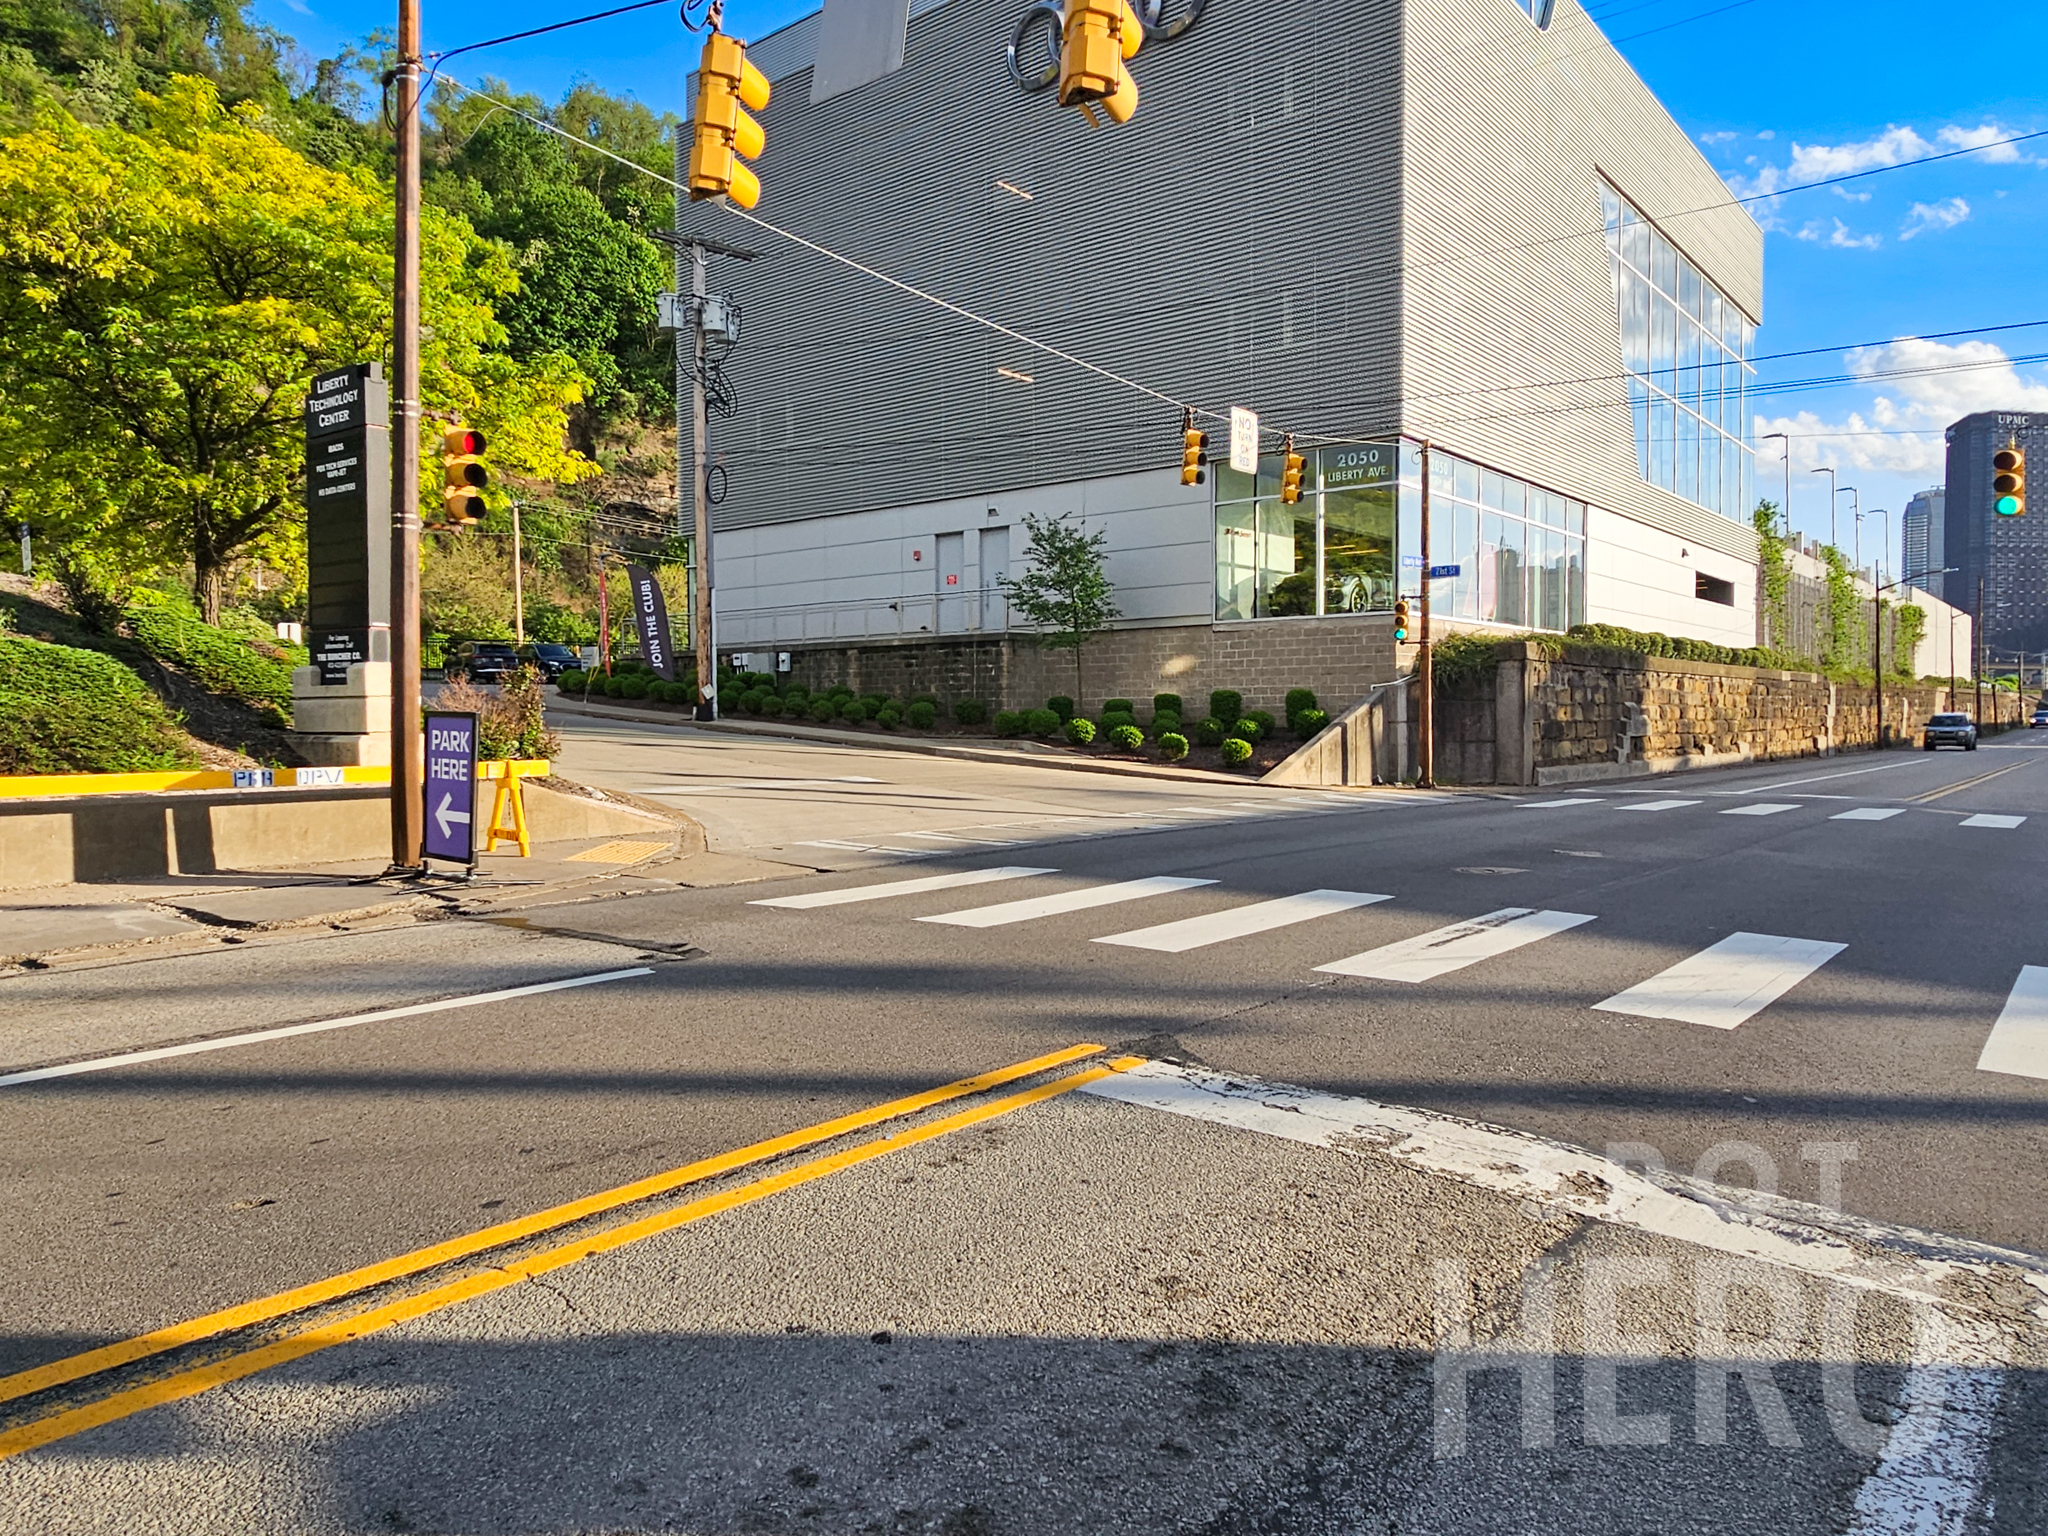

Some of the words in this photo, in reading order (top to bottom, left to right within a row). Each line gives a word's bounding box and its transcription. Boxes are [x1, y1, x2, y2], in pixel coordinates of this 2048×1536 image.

[317, 374, 349, 394] LIBERTY
[309, 389, 359, 413] TECHNOLOGY
[319, 410, 350, 427] CENTER
[1238, 416, 1252, 431] NO
[1998, 414, 2029, 425] UPMC
[1238, 430, 1253, 443] TURN
[1337, 449, 1379, 468] 2050
[1430, 457, 1449, 476] 2050
[1327, 468, 1364, 483] LIBERTY
[1435, 567, 1448, 576] 21st
[1448, 566, 1456, 575] St
[640, 580, 655, 613] CLUB!
[646, 615, 659, 638] THE
[649, 639, 664, 669] JOIN
[431, 729, 470, 753] PARK
[431, 757, 468, 781] HERE
